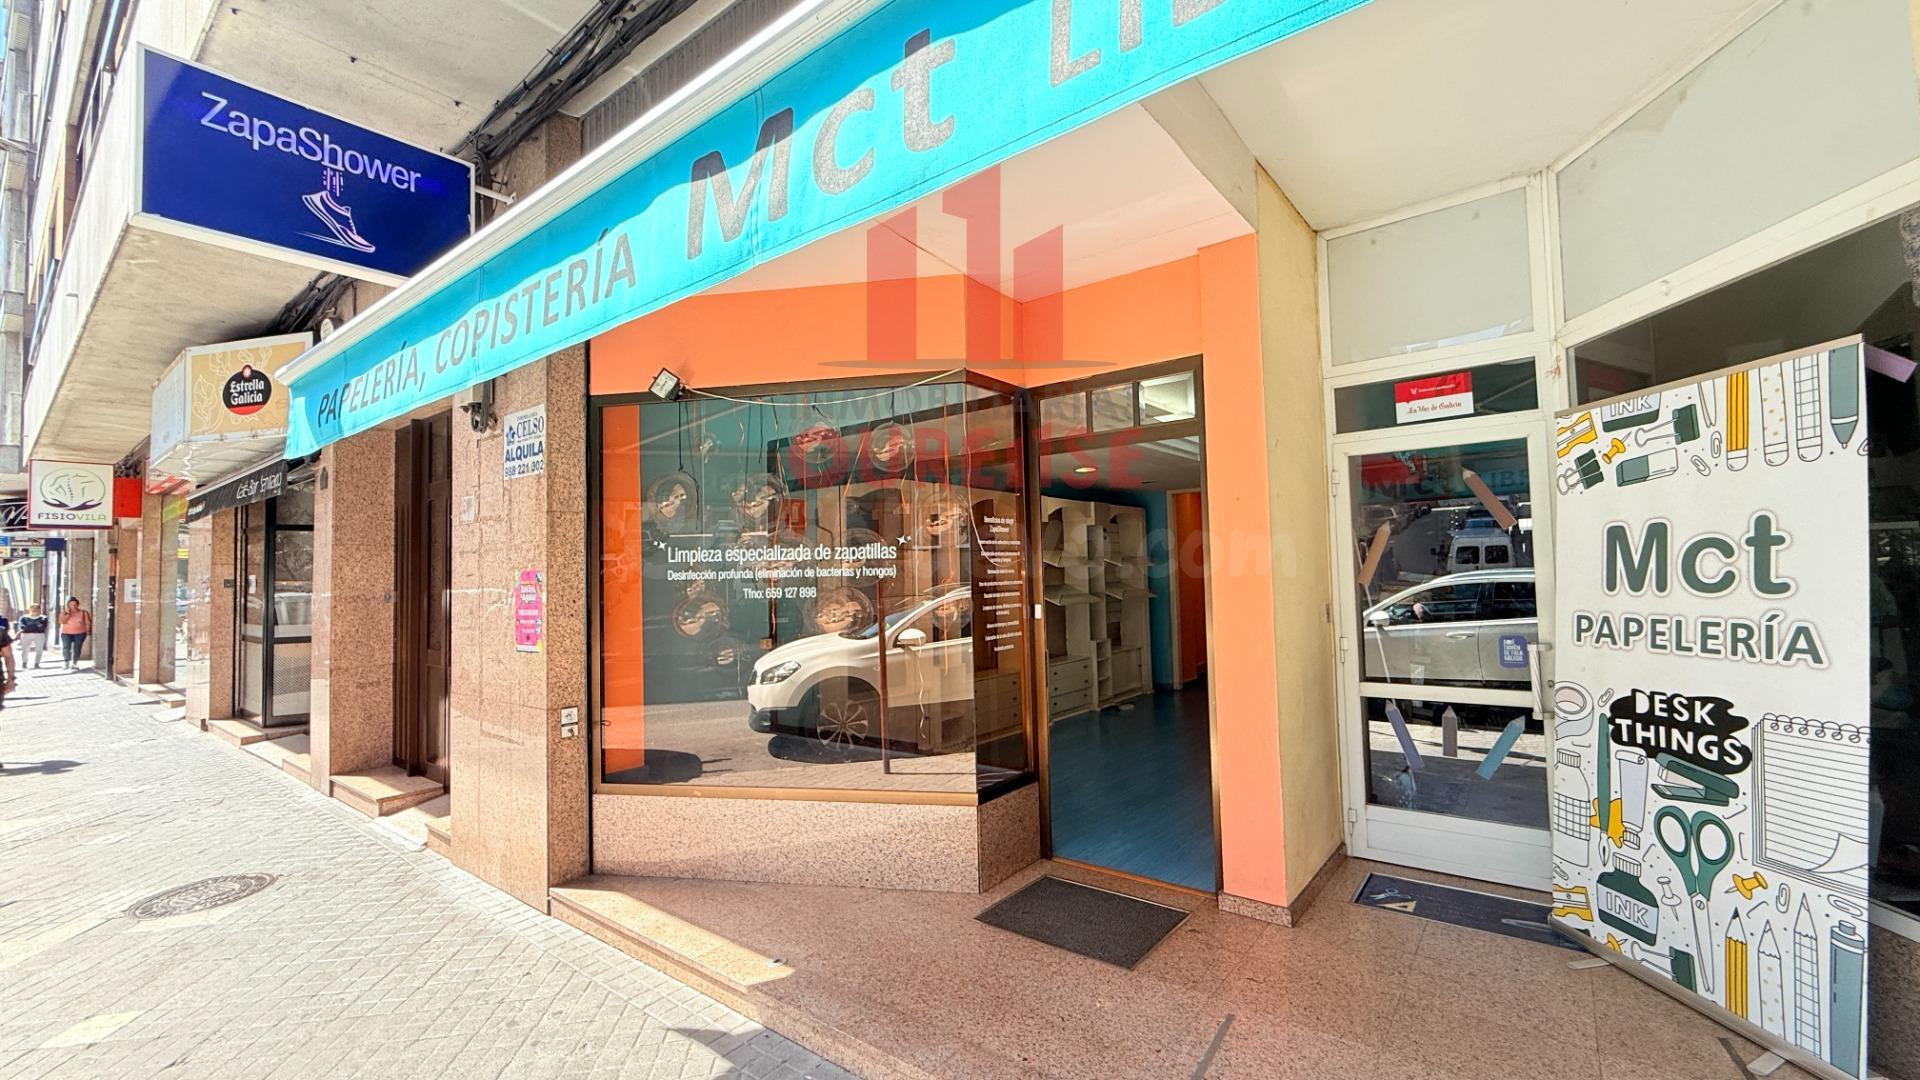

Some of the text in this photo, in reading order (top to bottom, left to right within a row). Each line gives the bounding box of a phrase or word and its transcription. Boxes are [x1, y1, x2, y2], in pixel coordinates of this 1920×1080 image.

[200, 90, 422, 194] ZapaShower
[318, 341, 426, 428] PAPELERÍA,
[435, 228, 637, 375] COPISTERÍA
[687, 28, 957, 261] Mct
[229, 379, 265, 393] Estrella
[230, 391, 263, 406] Galicia
[1610, 394, 1652, 418] INK
[517, 416, 544, 438] CELSO
[505, 441, 544, 463] ALQUILA
[517, 463, 530, 475] 221
[38, 513, 107, 522] FISIOVILA
[667, 542, 897, 566] Limpieza especializada de zapatillas
[1604, 513, 1792, 595] Mct
[667, 564, 897, 582] Desinfección profunda (eliminación de bacterias y hongos)
[742, 586, 817, 600] Tfno: 659 127 898
[1574, 612, 1825, 666] PAPELERÍA
[1635, 692, 1716, 727] DESK
[1614, 717, 1745, 767] THINGS
[1604, 890, 1651, 930] INK
